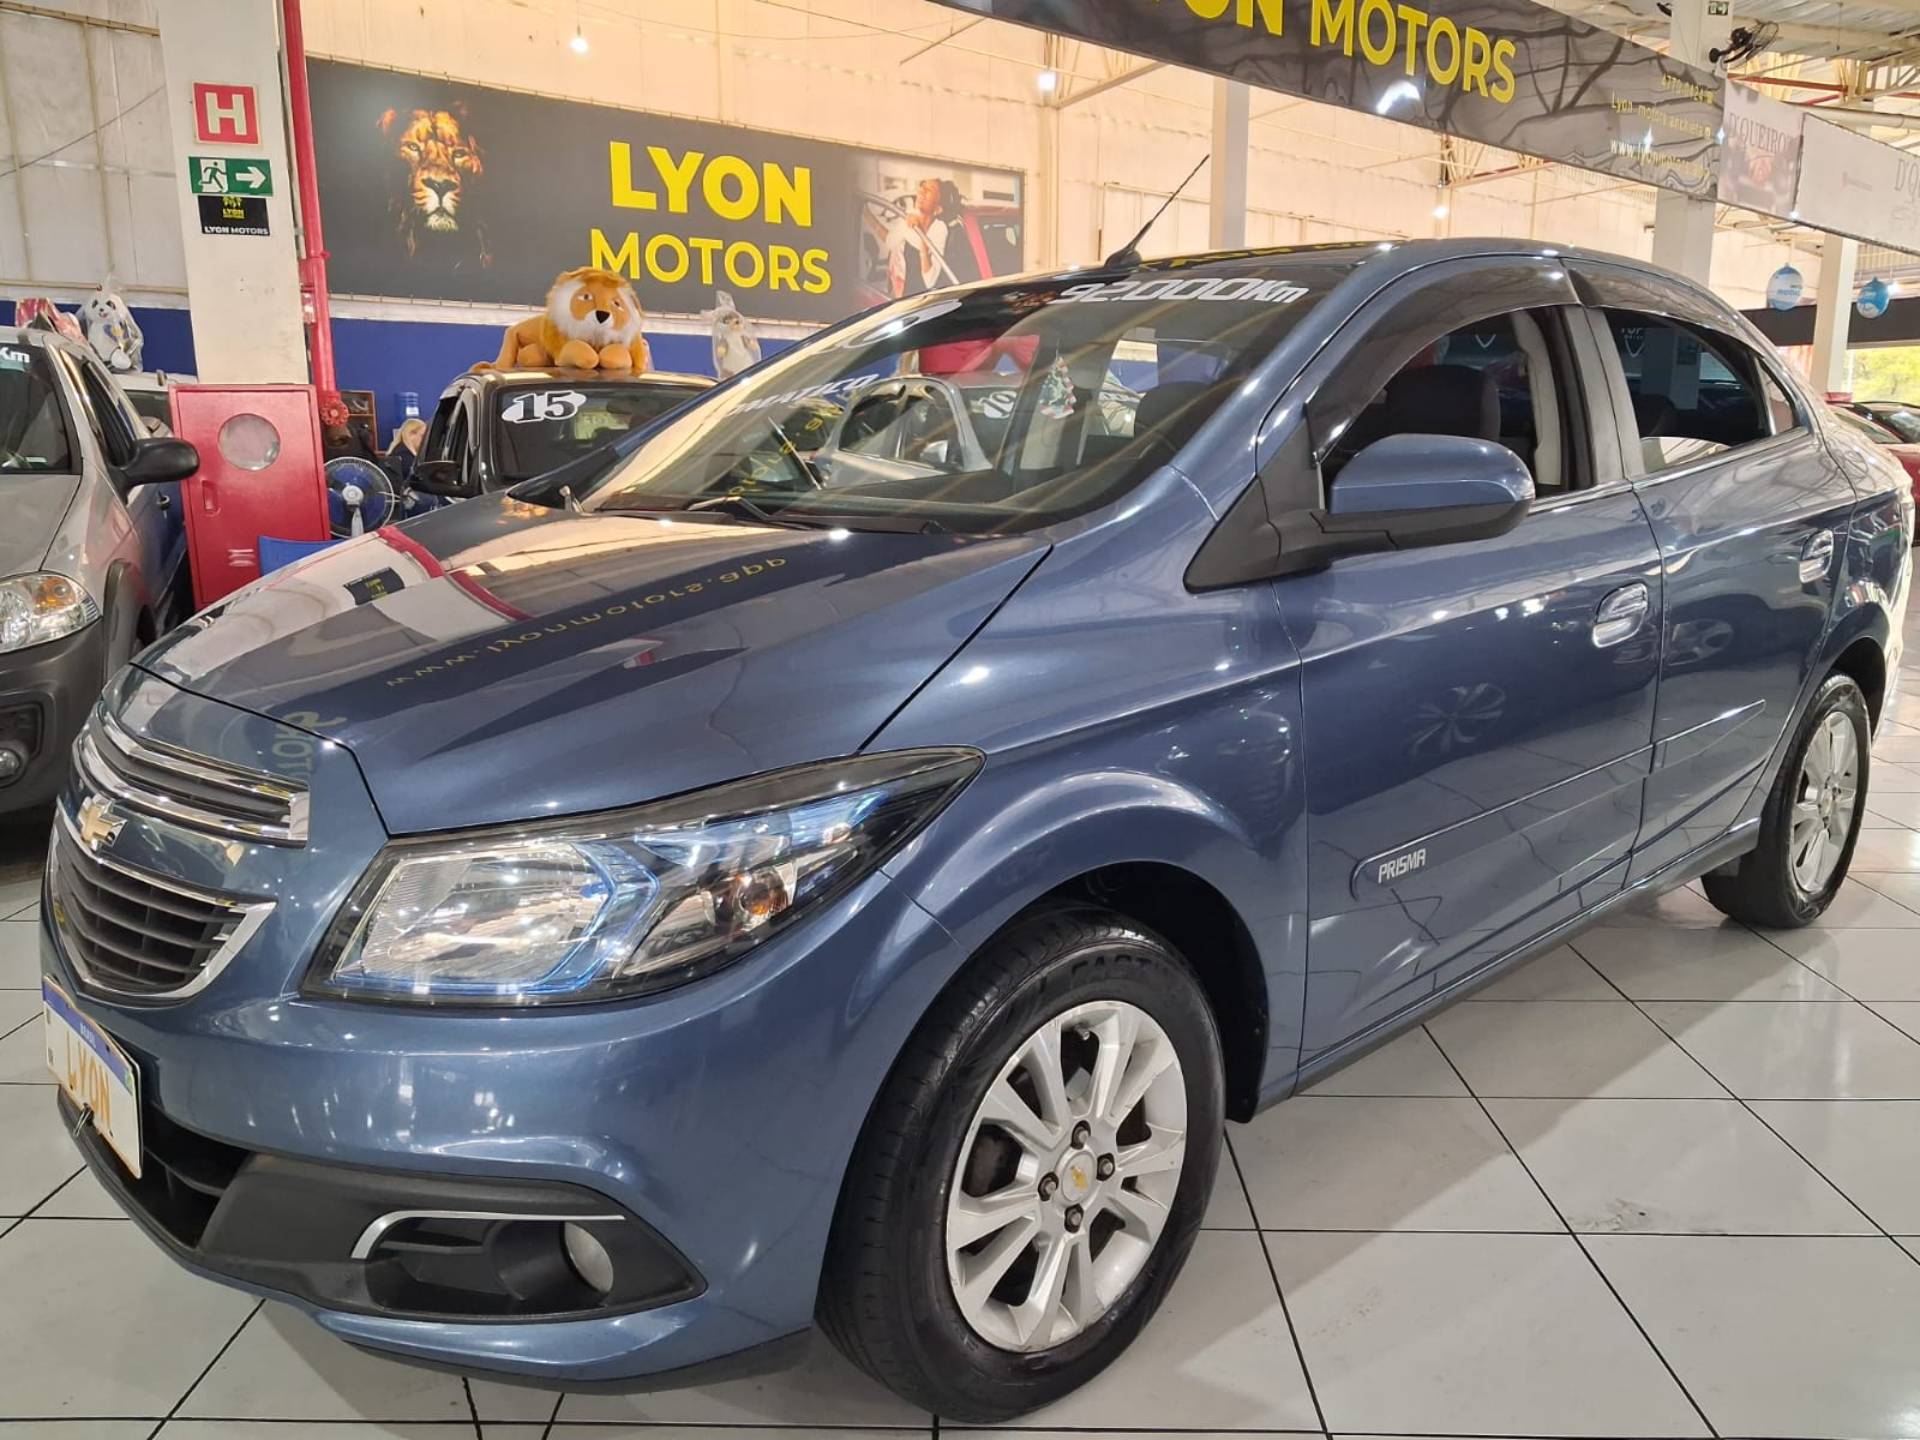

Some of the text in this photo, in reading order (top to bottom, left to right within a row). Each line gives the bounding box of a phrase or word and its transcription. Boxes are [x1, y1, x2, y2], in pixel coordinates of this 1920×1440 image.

[1309, 0, 1516, 104] MOTORS
[205, 92, 248, 136] H
[610, 140, 812, 227] LYON
[204, 226, 229, 234] LYON
[590, 228, 831, 294] MOTORS
[513, 390, 578, 423] 15
[1378, 848, 1426, 884] PRISMA
